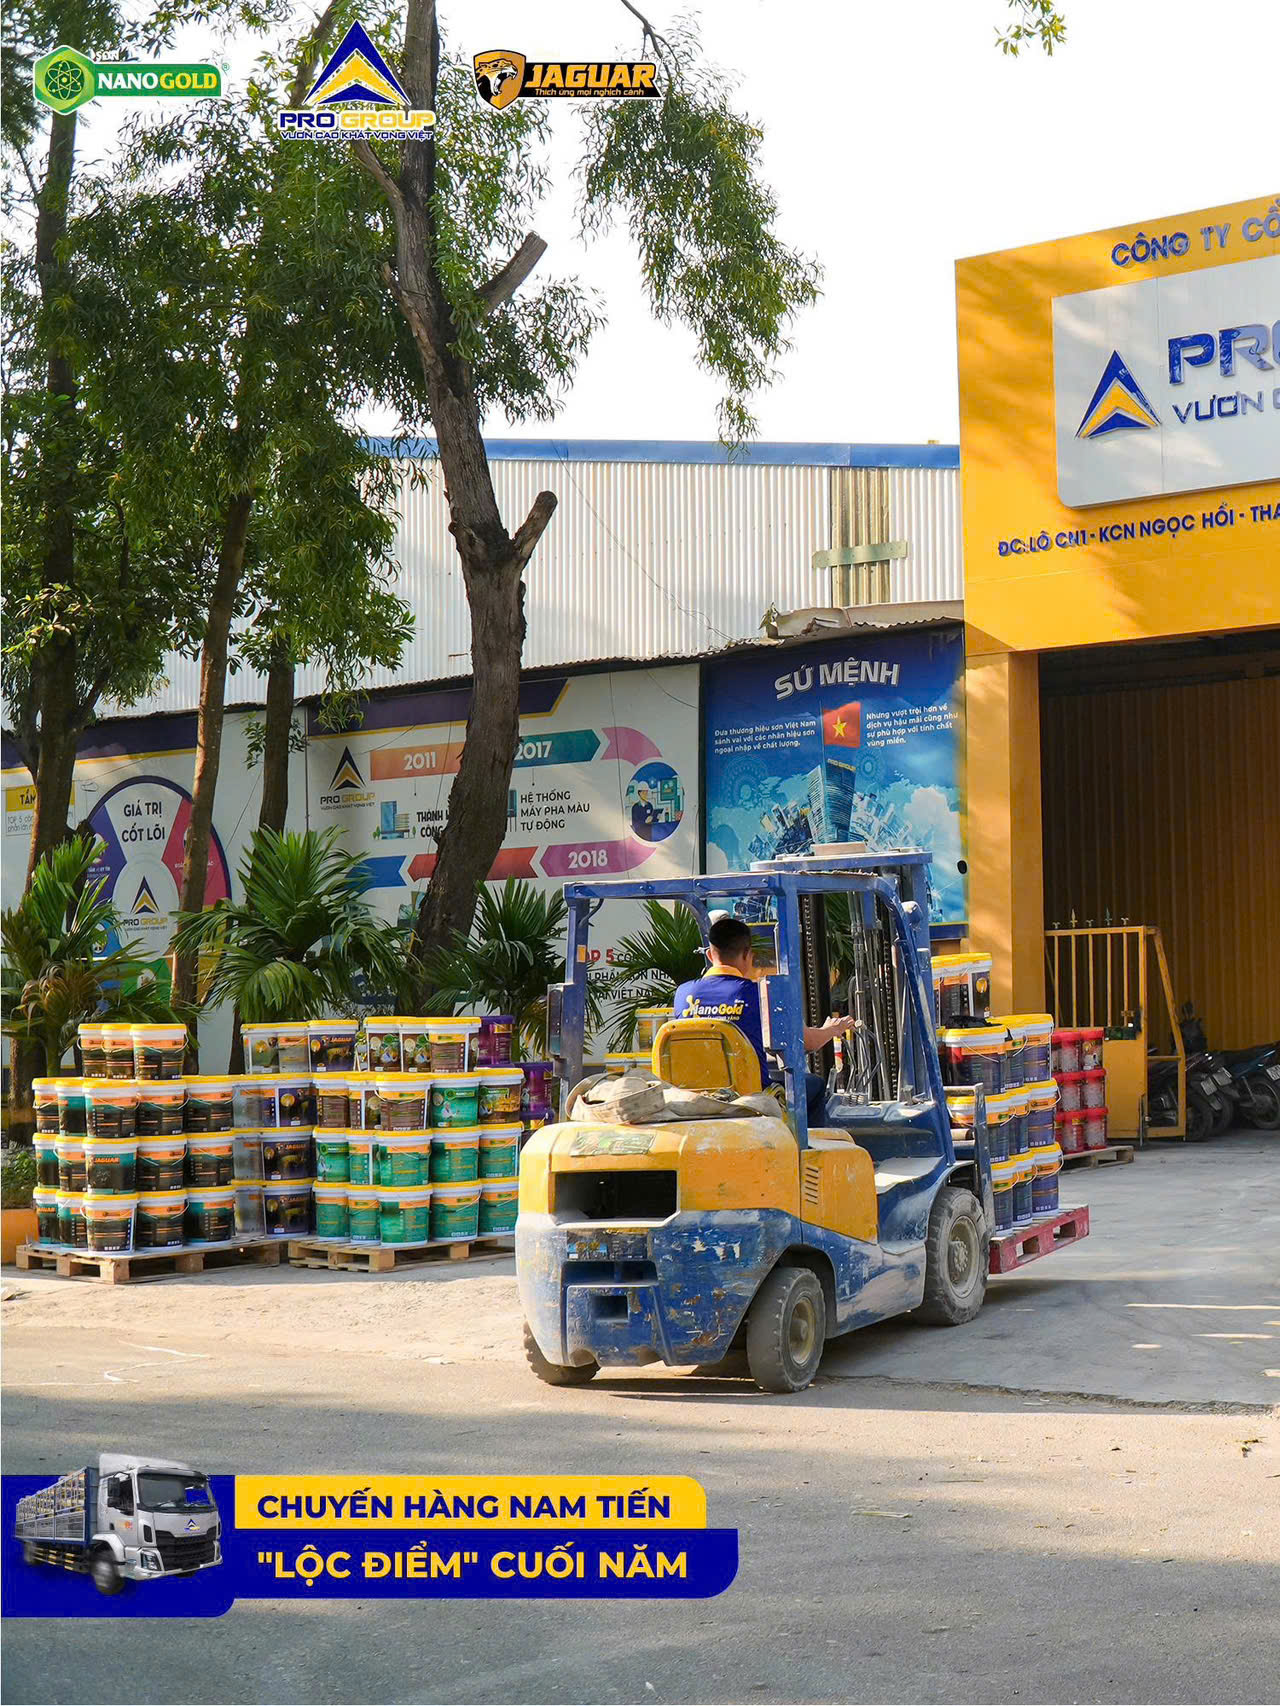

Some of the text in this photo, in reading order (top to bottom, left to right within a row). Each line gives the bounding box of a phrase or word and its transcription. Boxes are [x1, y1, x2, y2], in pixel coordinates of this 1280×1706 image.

[1111, 232, 1190, 267] CÔNG
[1200, 223, 1231, 250] TY
[1172, 391, 1265, 424] VƯƠN
[1099, 523, 1135, 542] KCN
[1139, 514, 1196, 538] NGỌC
[774, 656, 899, 700] SỨ MỆNH
[800, 720, 816, 728] Nam
[514, 741, 552, 760] 2017
[404, 751, 436, 771] 2011
[320, 792, 376, 805] PRO GROUP
[520, 788, 571, 805] HỆ THỐNG
[123, 799, 162, 817] GIÁ TRỊ
[417, 810, 443, 822] THÀNH
[520, 801, 590, 817] MÁY PHA MÀU
[122, 823, 165, 842] CỐT LÕI
[520, 818, 566, 833] TỰ ĐỘNG
[568, 850, 608, 869] 2018
[123, 918, 139, 926] PRO
